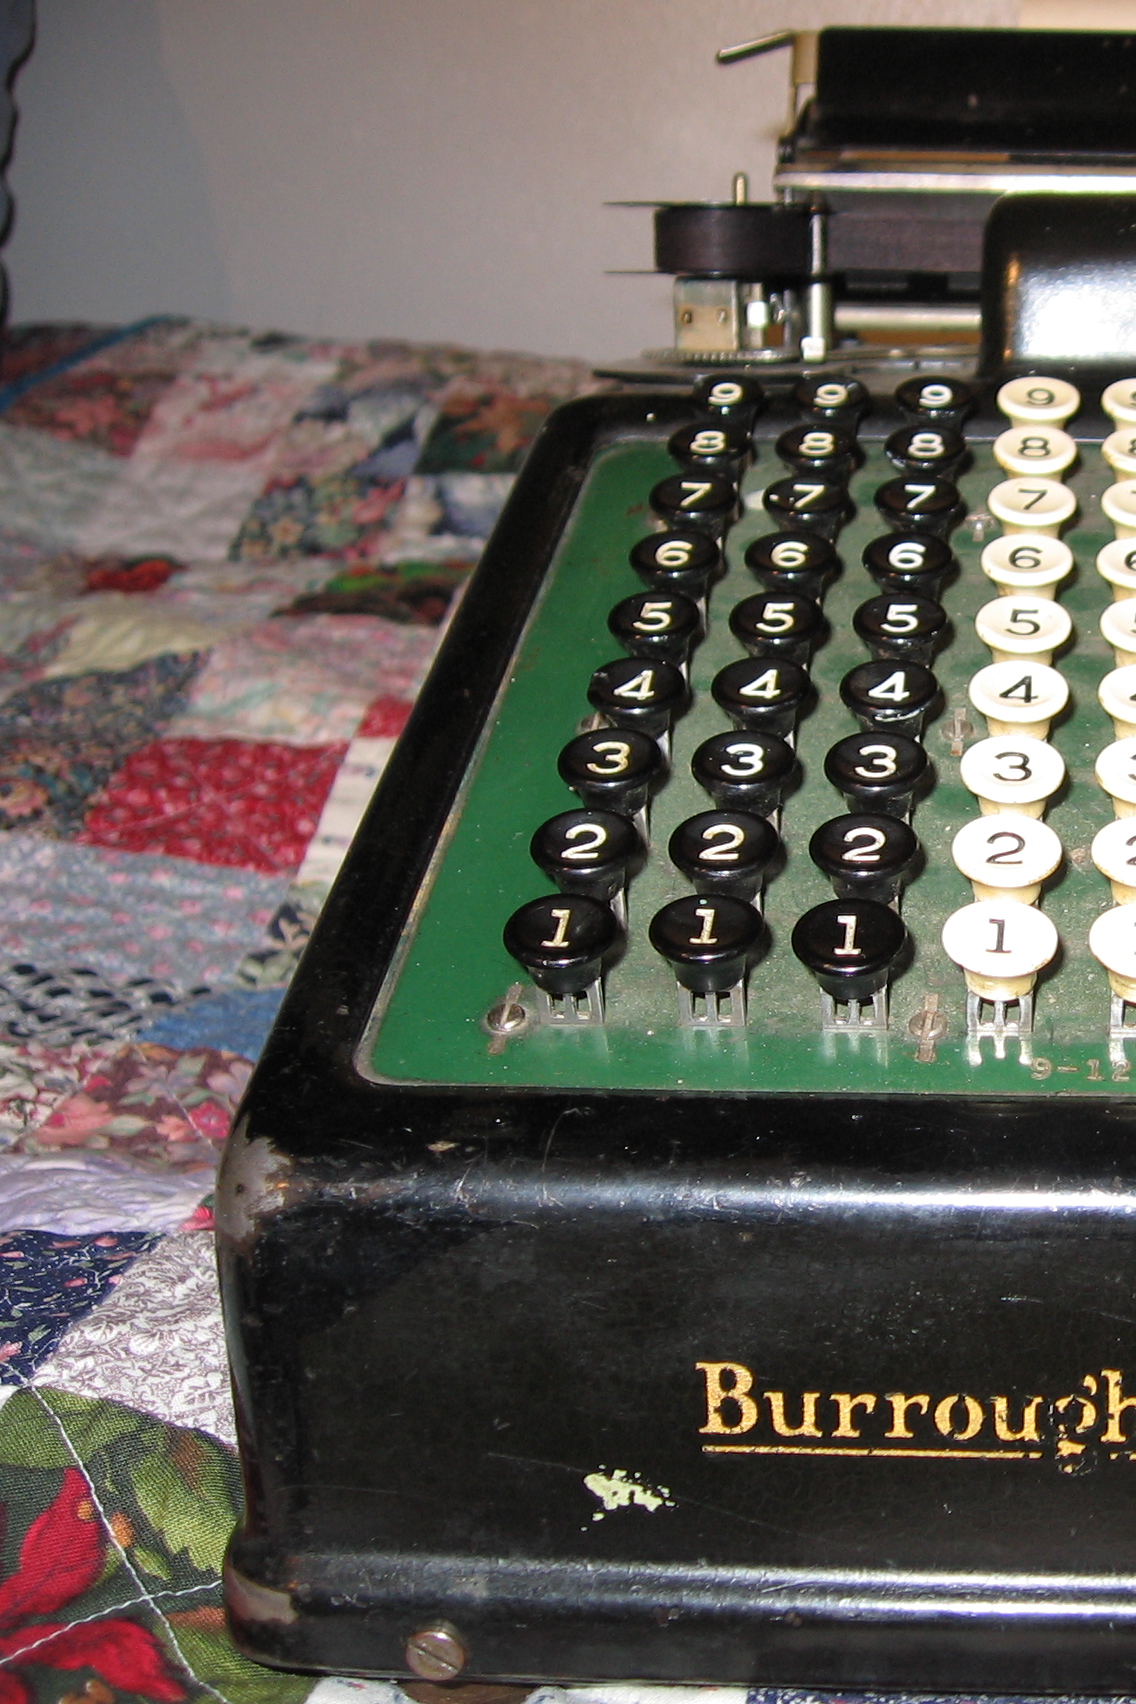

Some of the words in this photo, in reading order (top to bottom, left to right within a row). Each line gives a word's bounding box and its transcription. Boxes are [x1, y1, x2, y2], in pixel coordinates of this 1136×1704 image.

[708, 382, 743, 406] 9
[813, 383, 848, 407] 9
[919, 384, 953, 408] 9
[1025, 387, 1056, 408] 9
[690, 430, 726, 455] 8
[798, 431, 834, 457] 8
[908, 432, 945, 458] 8
[1017, 436, 1052, 459] 8
[680, 481, 712, 507] 7
[793, 483, 825, 508] 7
[904, 484, 936, 509] 7
[1018, 488, 1048, 512] 7
[655, 540, 693, 567] 6
[771, 541, 809, 568] 6
[888, 542, 926, 570] 6
[1008, 546, 1043, 570] 6
[632, 601, 672, 632] 5
[756, 602, 795, 633] 5
[880, 604, 919, 633] 5
[1005, 608, 1041, 636] 5
[613, 669, 655, 701] 4
[739, 668, 781, 699] 4
[868, 671, 910, 702] 4
[998, 675, 1039, 704] 4
[586, 741, 630, 775] 3
[721, 743, 764, 777] 3
[854, 744, 897, 779] 3
[992, 751, 1033, 782] 3
[561, 823, 607, 860] 2
[698, 823, 745, 861] 2
[842, 826, 886, 862] 2
[985, 831, 1026, 865] 2
[541, 908, 571, 948] 1
[689, 908, 718, 944] 1
[834, 915, 862, 956] 1
[985, 918, 1012, 954] 1
